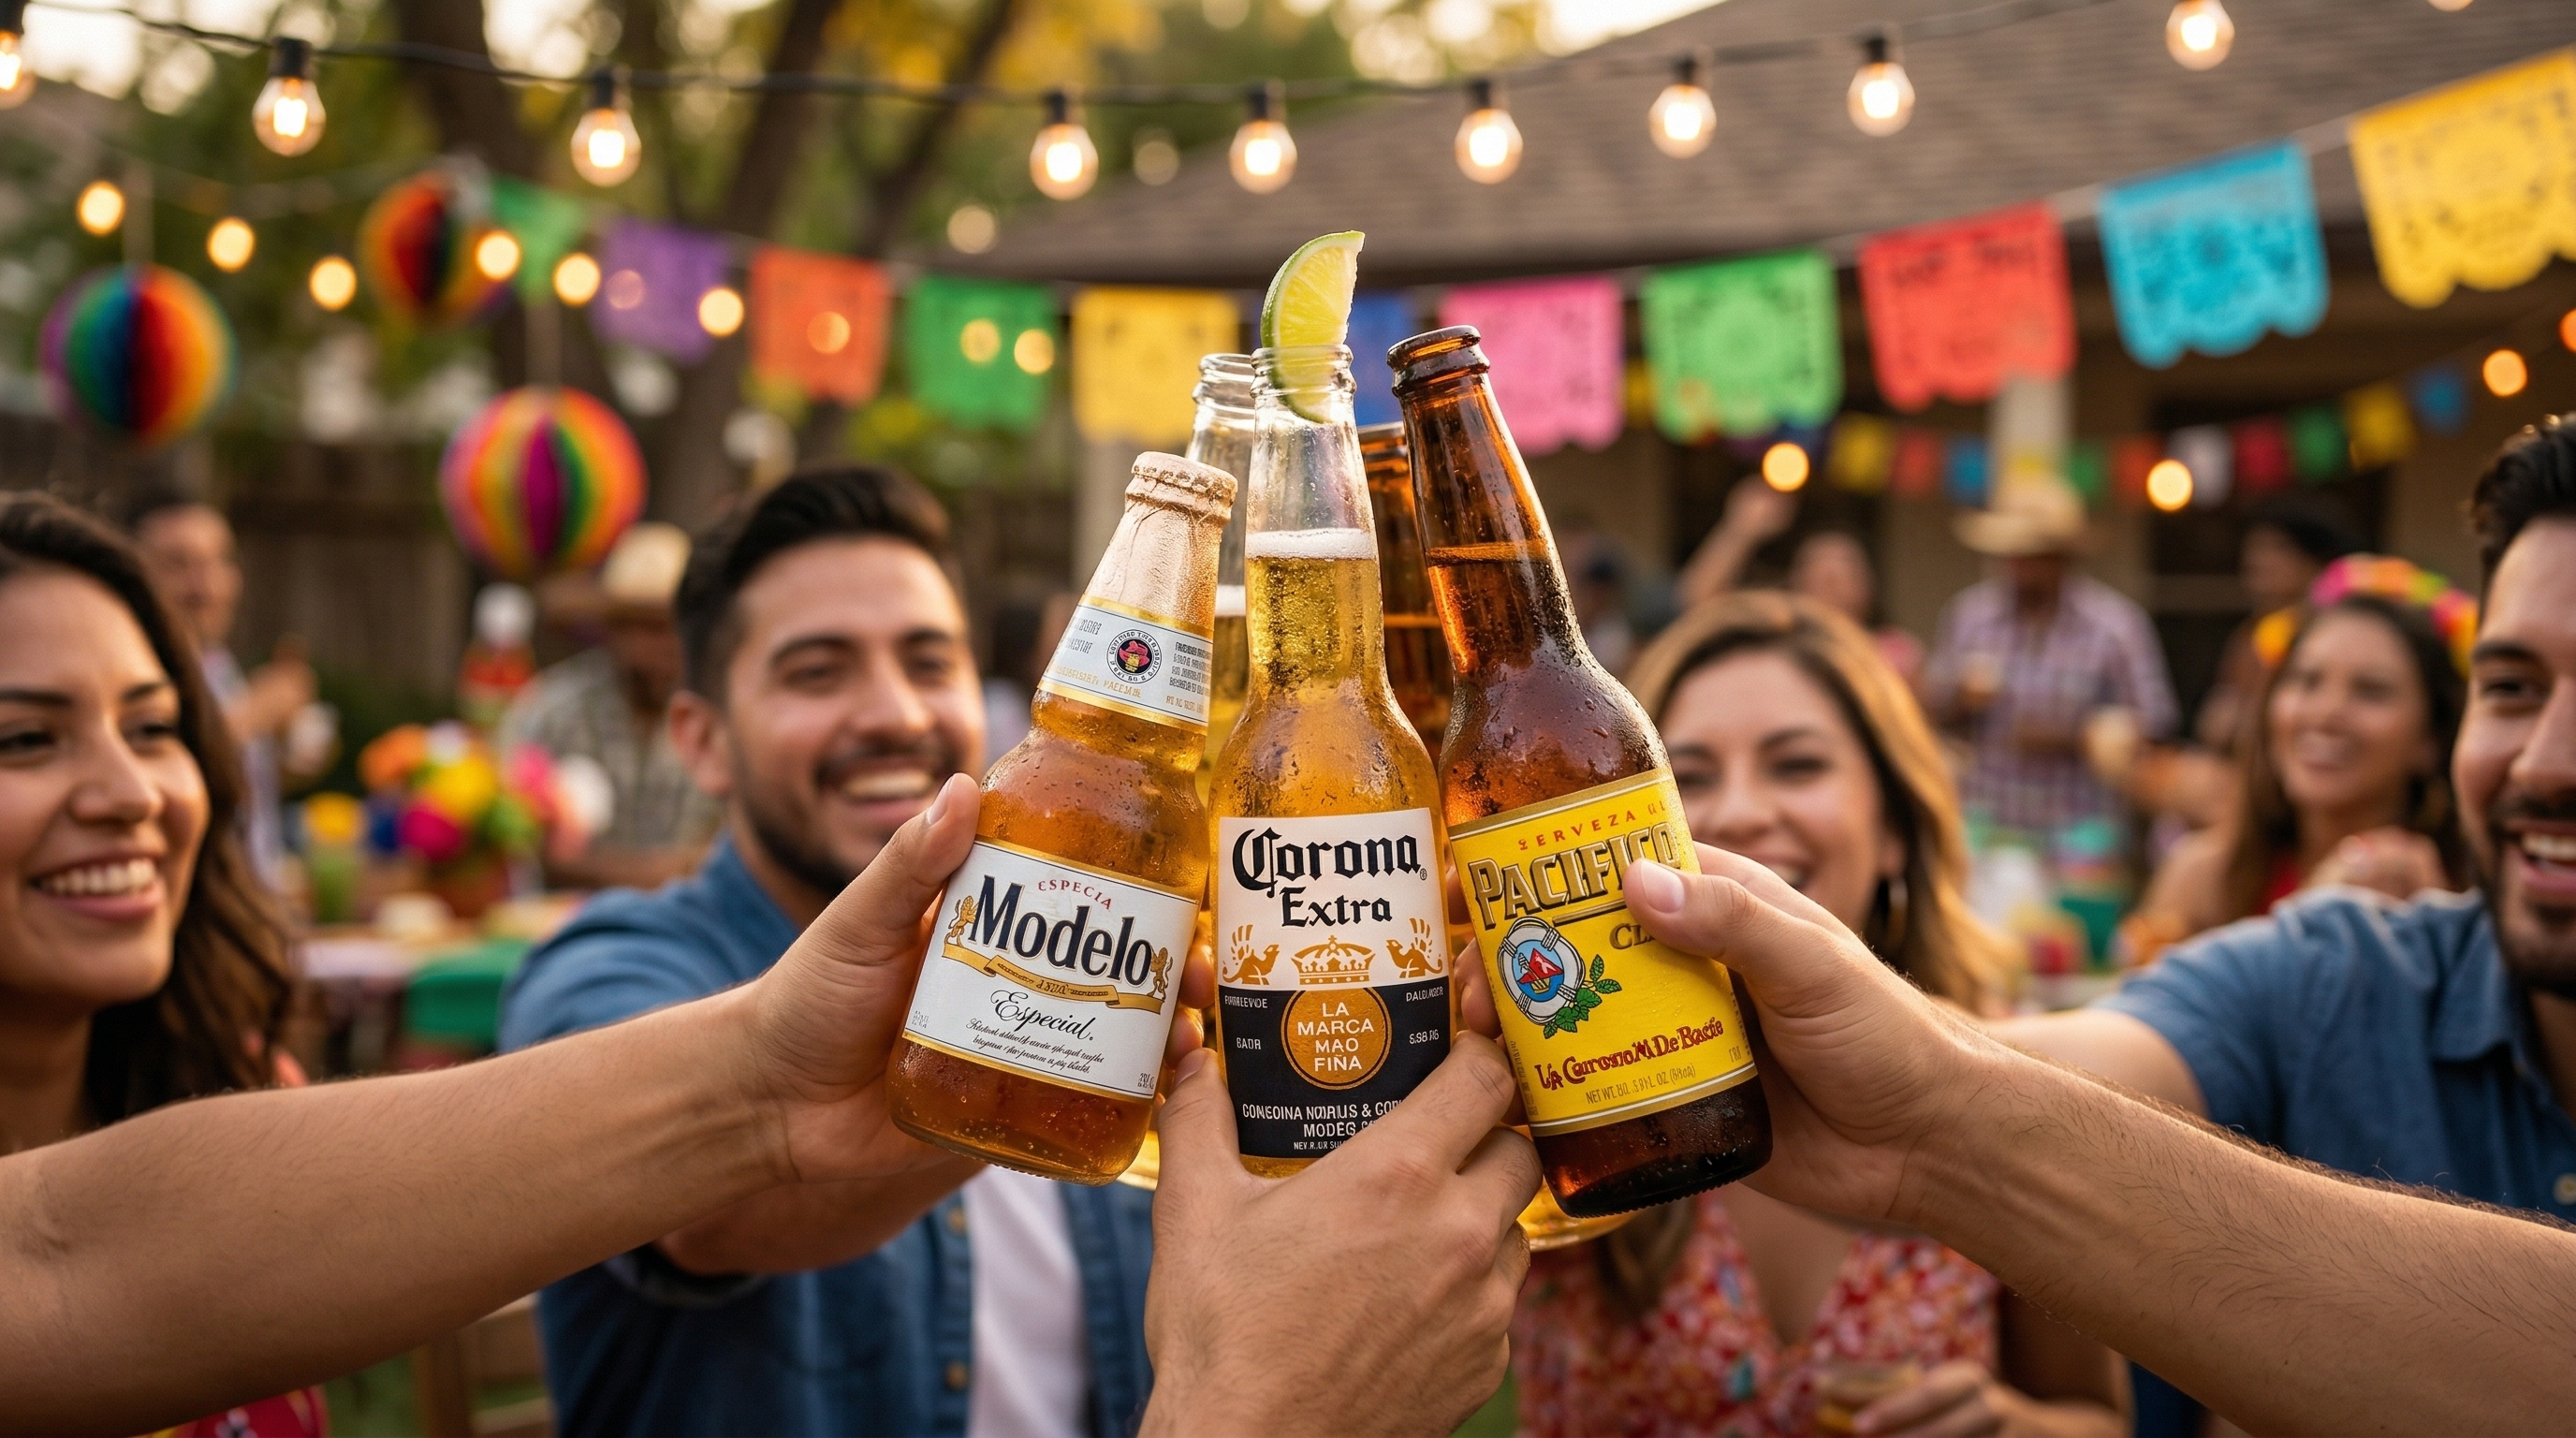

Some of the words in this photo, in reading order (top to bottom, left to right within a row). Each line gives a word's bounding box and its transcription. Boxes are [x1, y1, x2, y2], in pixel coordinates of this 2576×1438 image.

[1232, 827, 1422, 899] Corona
[1279, 886, 1393, 929] Extra
[967, 873, 1153, 987] Modelo
[1322, 1002, 1350, 1018] LA
[1297, 1018, 1375, 1036] MARCA
[1315, 1037, 1359, 1053] MAO
